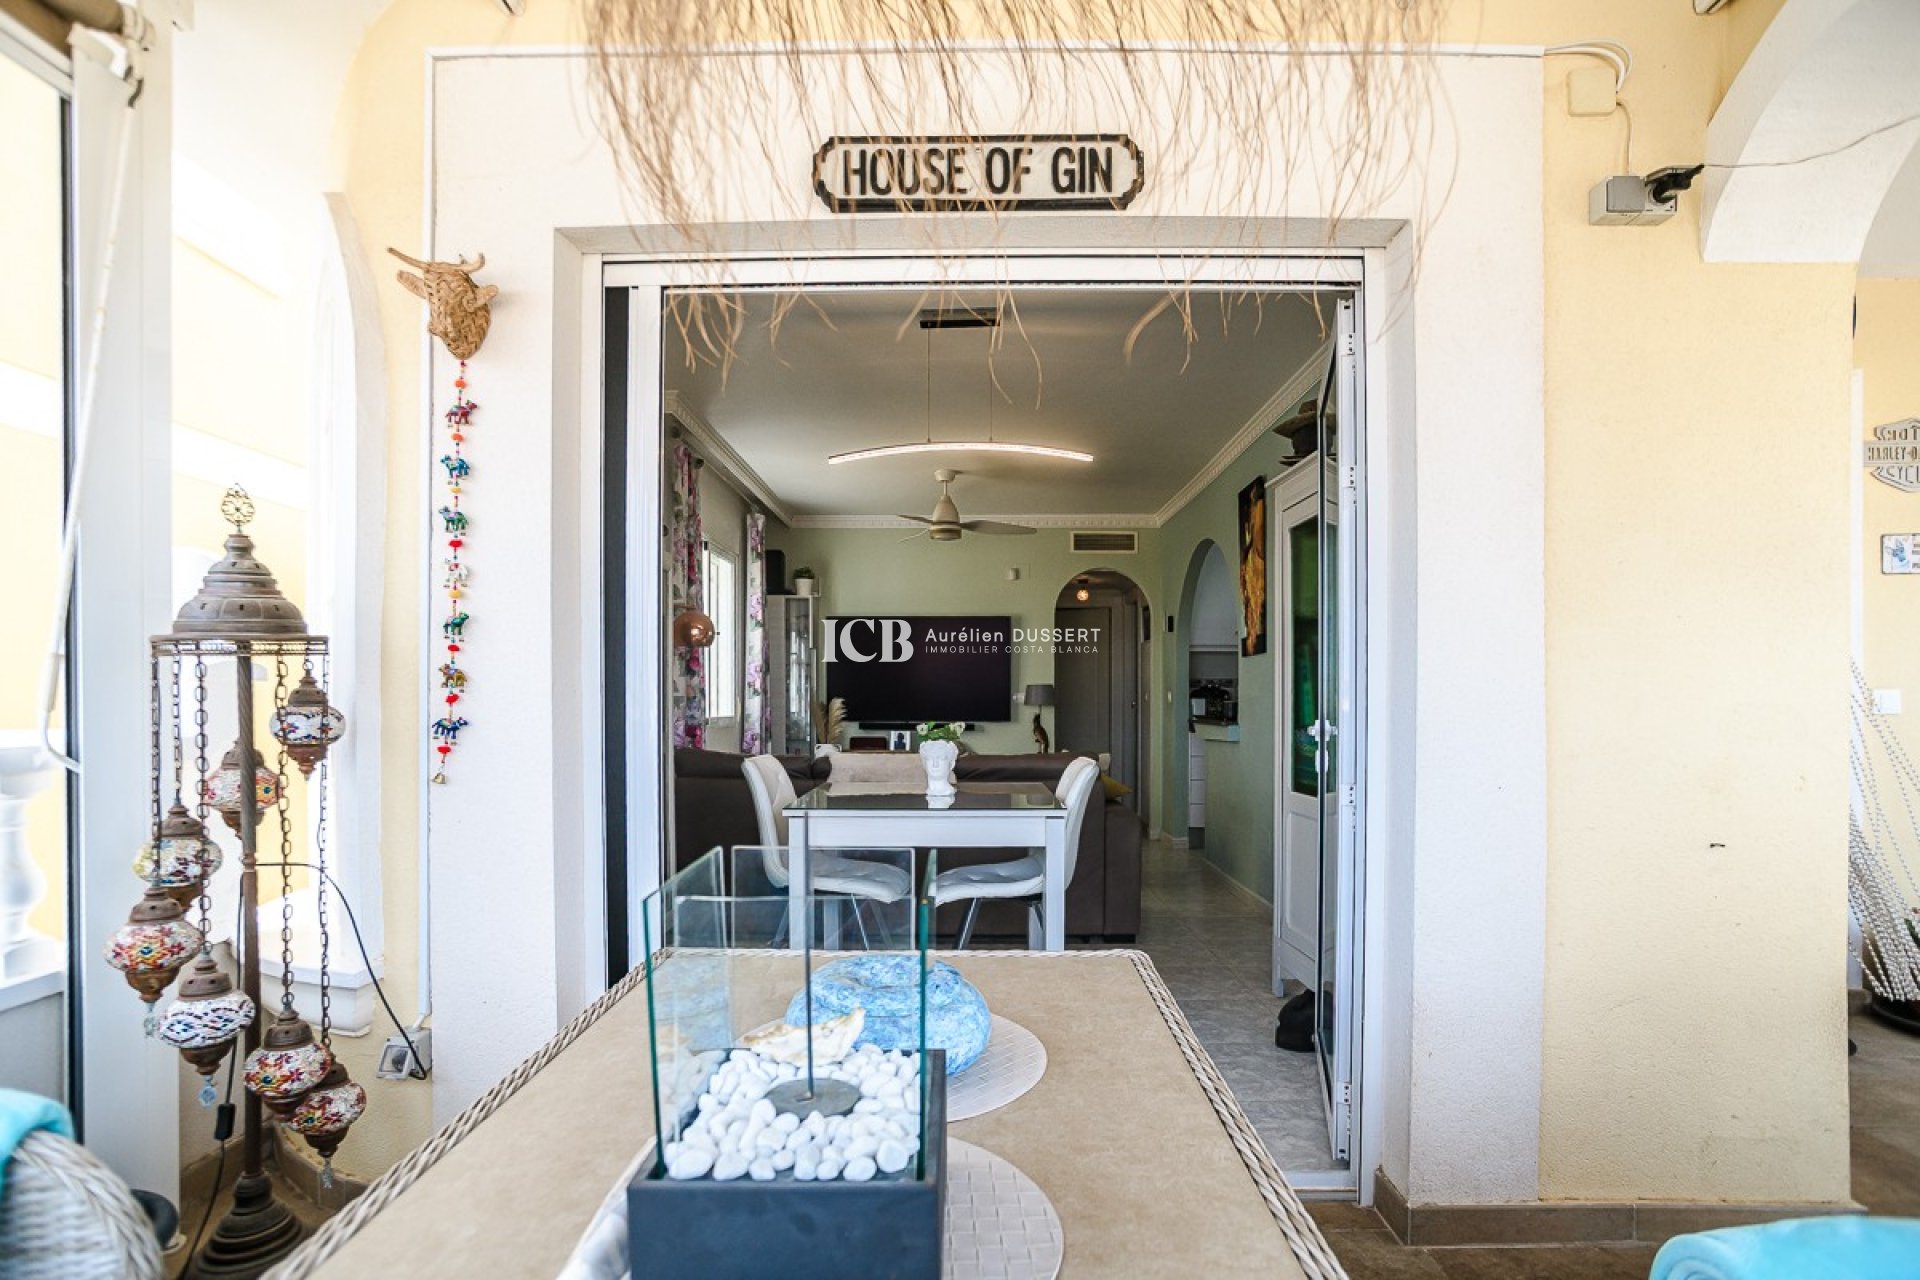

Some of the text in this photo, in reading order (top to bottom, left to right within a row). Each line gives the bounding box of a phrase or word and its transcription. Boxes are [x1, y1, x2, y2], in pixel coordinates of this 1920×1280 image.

[843, 147, 1113, 195] HOUSE OF GIN
